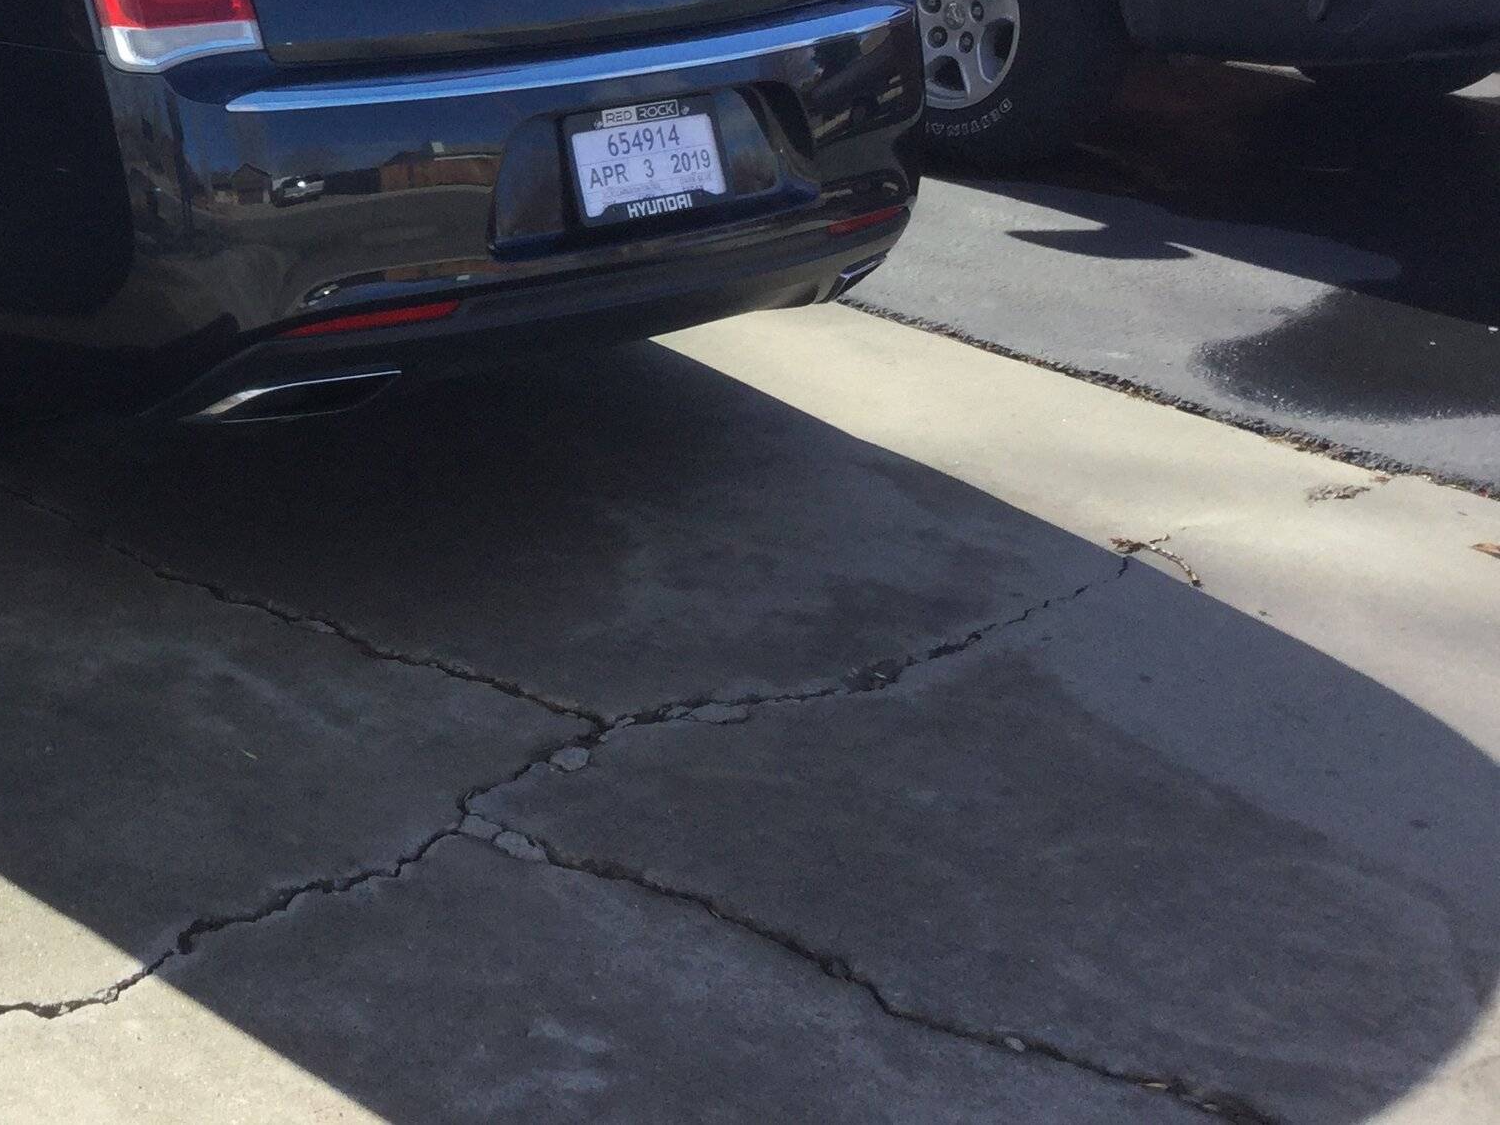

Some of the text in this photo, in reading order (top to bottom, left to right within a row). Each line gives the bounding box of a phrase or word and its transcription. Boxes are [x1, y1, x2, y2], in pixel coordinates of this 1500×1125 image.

[605, 103, 676, 124] RED ROCK
[607, 124, 680, 157] 654914
[589, 164, 629, 189] APR
[643, 159, 654, 178] 3
[671, 149, 711, 174] 2019
[626, 194, 693, 219] HYUNDAI
